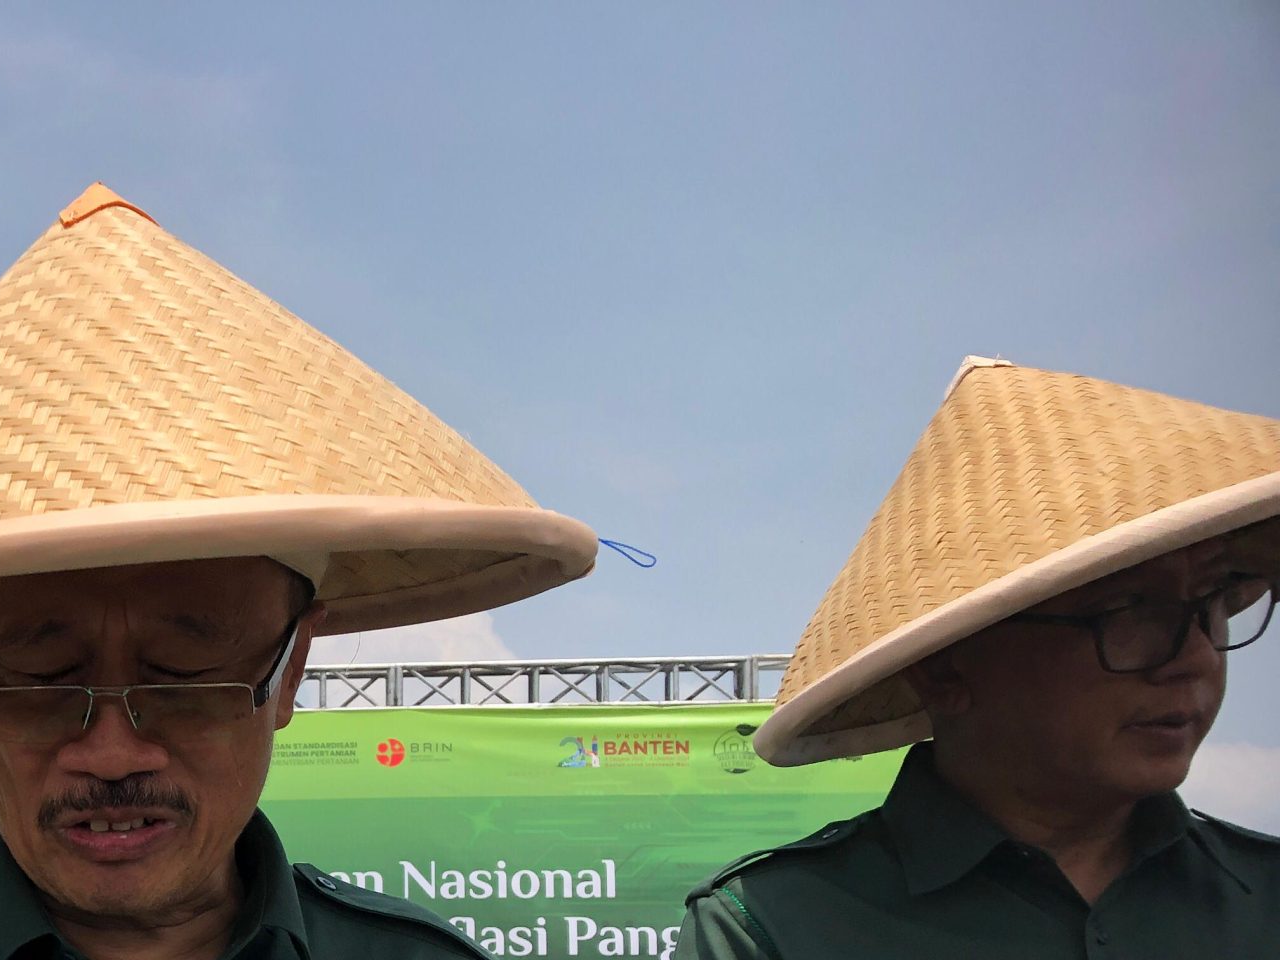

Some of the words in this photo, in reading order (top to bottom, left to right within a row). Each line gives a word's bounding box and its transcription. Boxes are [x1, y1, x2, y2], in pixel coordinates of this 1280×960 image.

[410, 742, 452, 752] BRIN
[604, 740, 689, 755] BANTEN
[399, 860, 616, 900] Nasional
